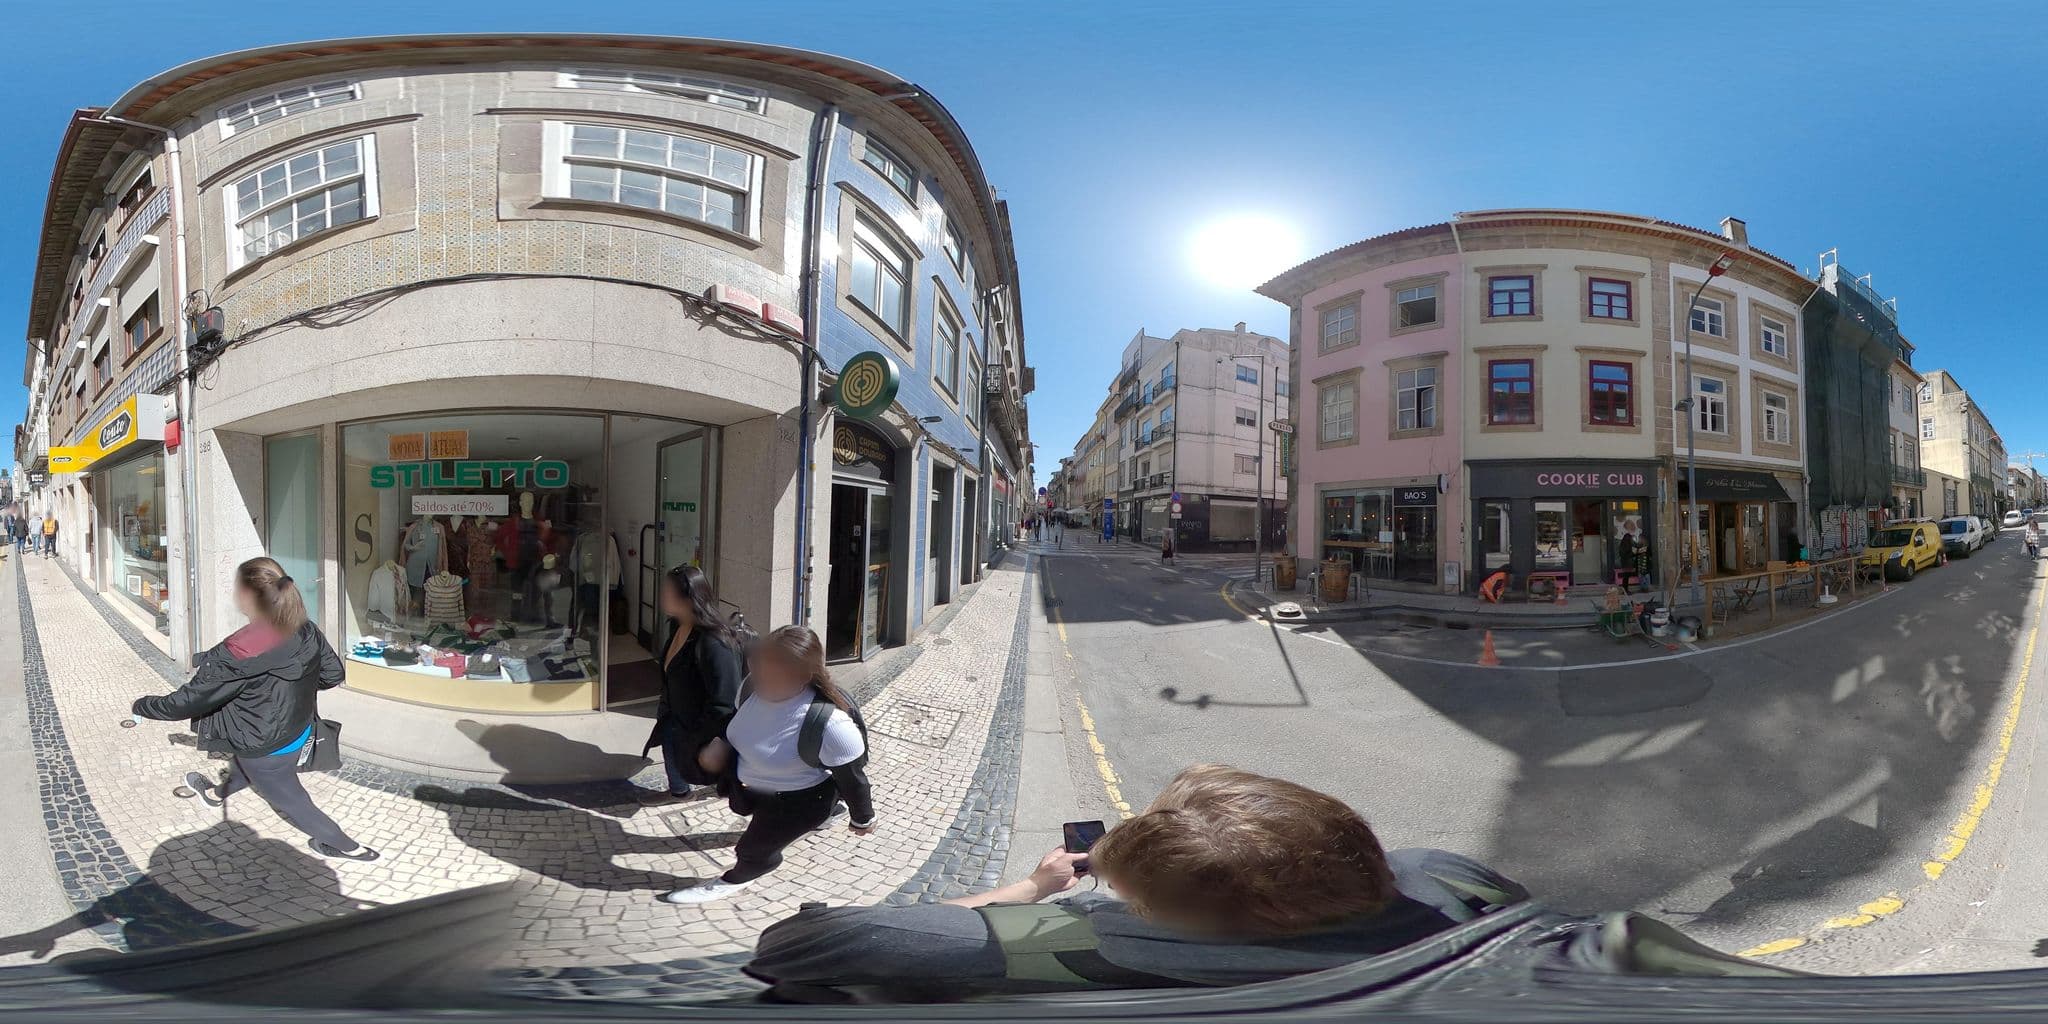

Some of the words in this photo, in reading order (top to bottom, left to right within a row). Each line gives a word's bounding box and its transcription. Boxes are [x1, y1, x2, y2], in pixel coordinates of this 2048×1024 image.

[371, 460, 569, 488] STILETTO
[1537, 473, 1600, 486] COOKIE
[1607, 473, 1644, 485] CLUB
[1404, 491, 1427, 500] BAO'S
[413, 501, 448, 512] Saldos
[450, 501, 467, 512] até
[469, 501, 494, 512] 70%
